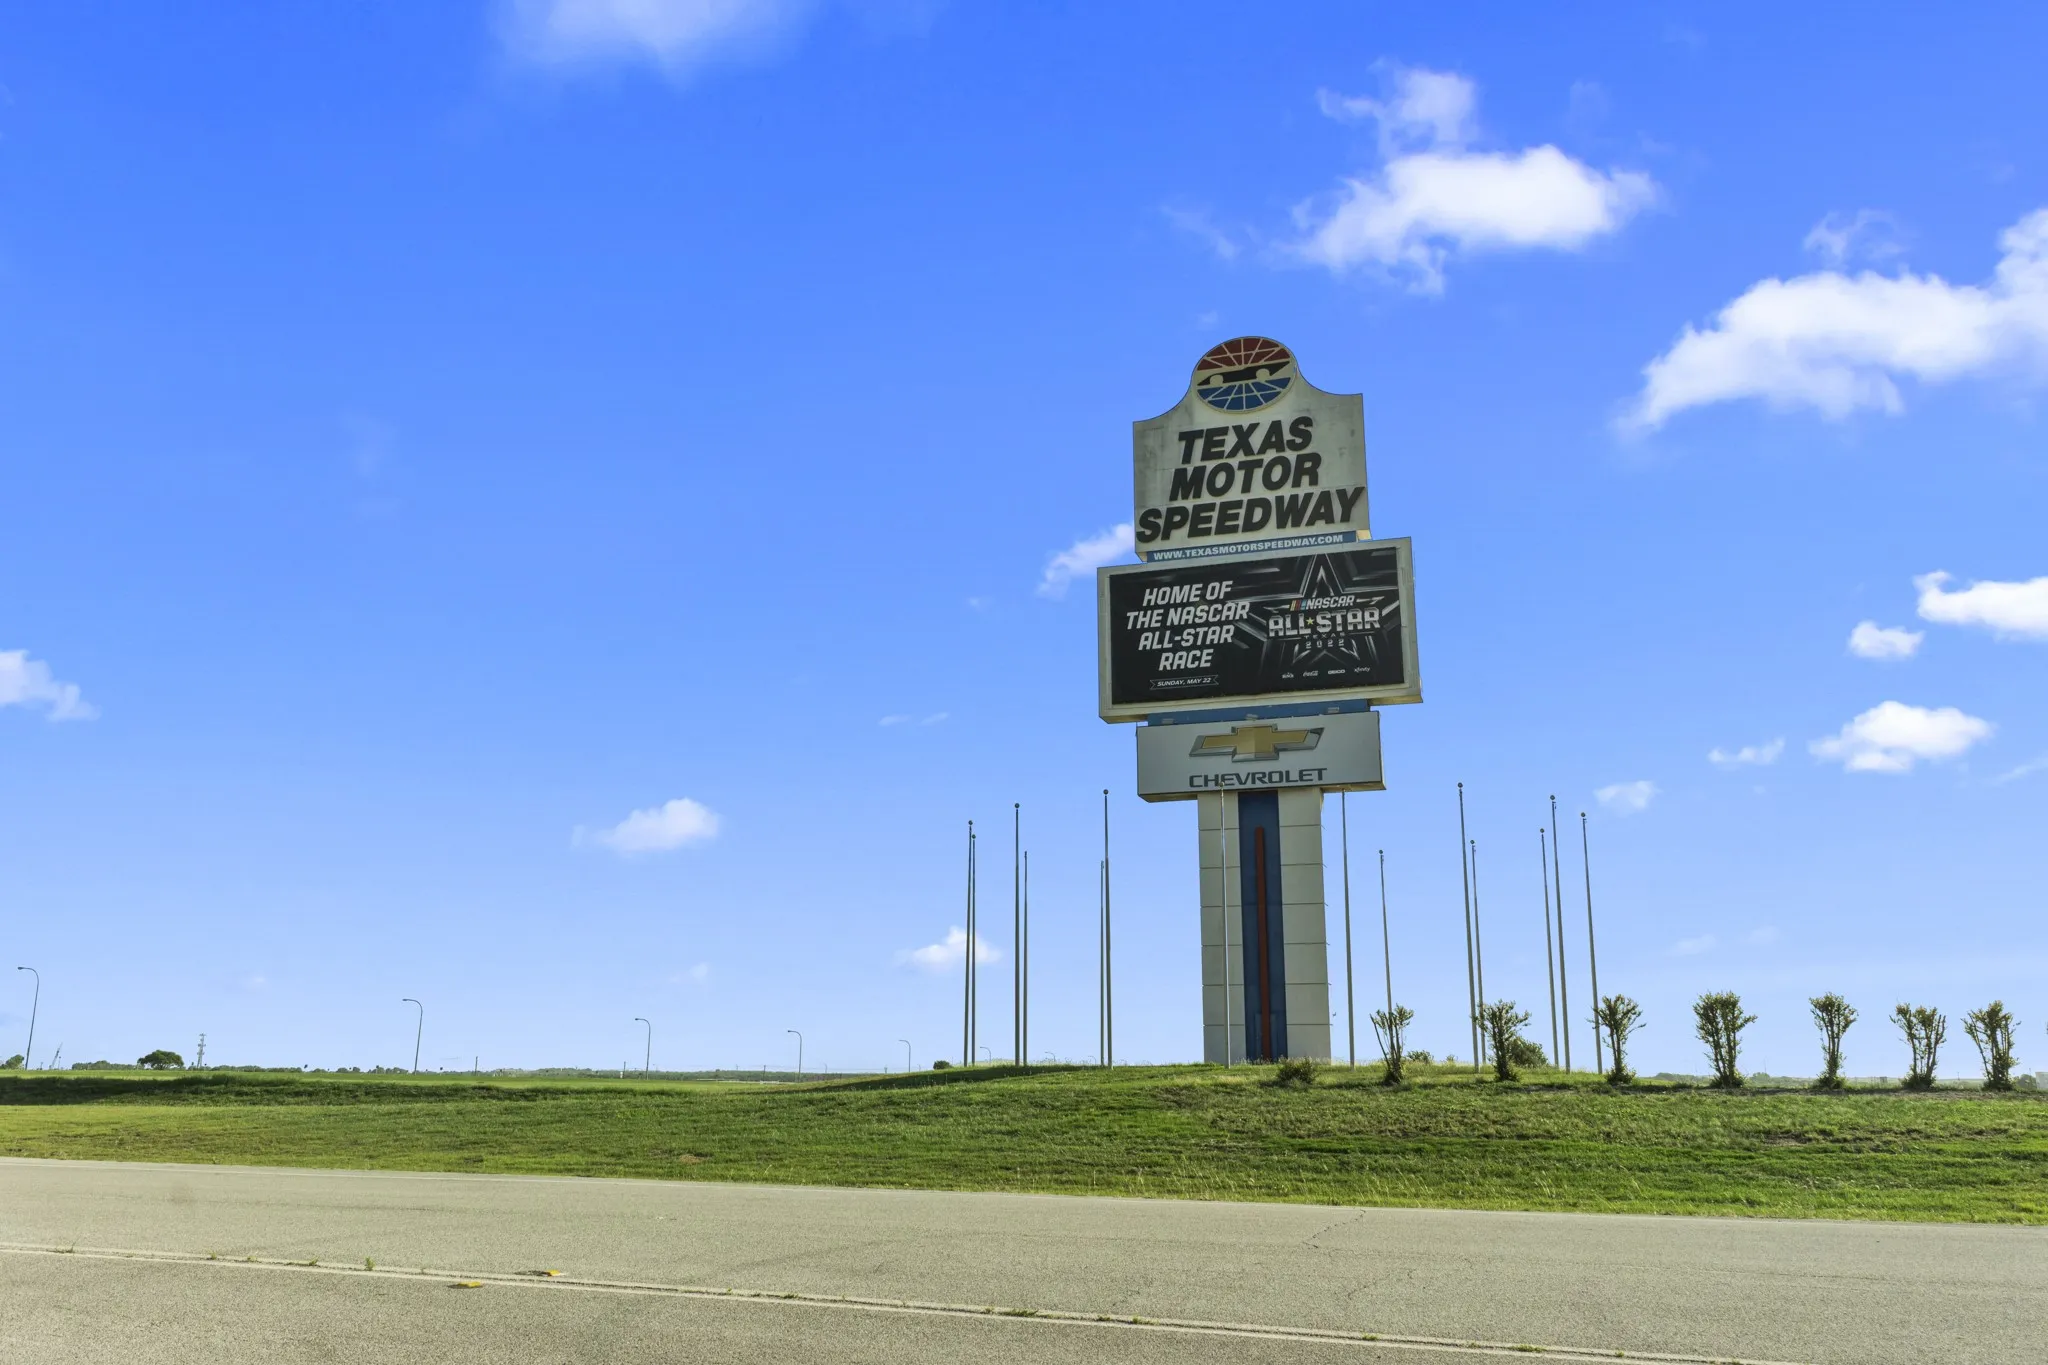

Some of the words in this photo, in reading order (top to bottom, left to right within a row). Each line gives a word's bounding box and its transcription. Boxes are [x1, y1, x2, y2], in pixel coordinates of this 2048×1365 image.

[1178, 416, 1313, 464] TEXAS
[1169, 452, 1322, 501] MOTOR
[1136, 486, 1365, 543] SPEEDWAY
[1154, 535, 1343, 560] WWW.TEXASMOTORSPEEDWAY.COM
[1143, 584, 1203, 607] HOME
[1206, 581, 1233, 601] OF
[1305, 595, 1355, 610] NASCAR
[1126, 610, 1165, 629] THE
[1166, 602, 1250, 626] NASCAR
[1138, 625, 1234, 650] ALL-STAR
[1305, 639, 1345, 649] 2022
[1159, 649, 1214, 671] RACE
[1189, 768, 1327, 788] CHEVROLET
